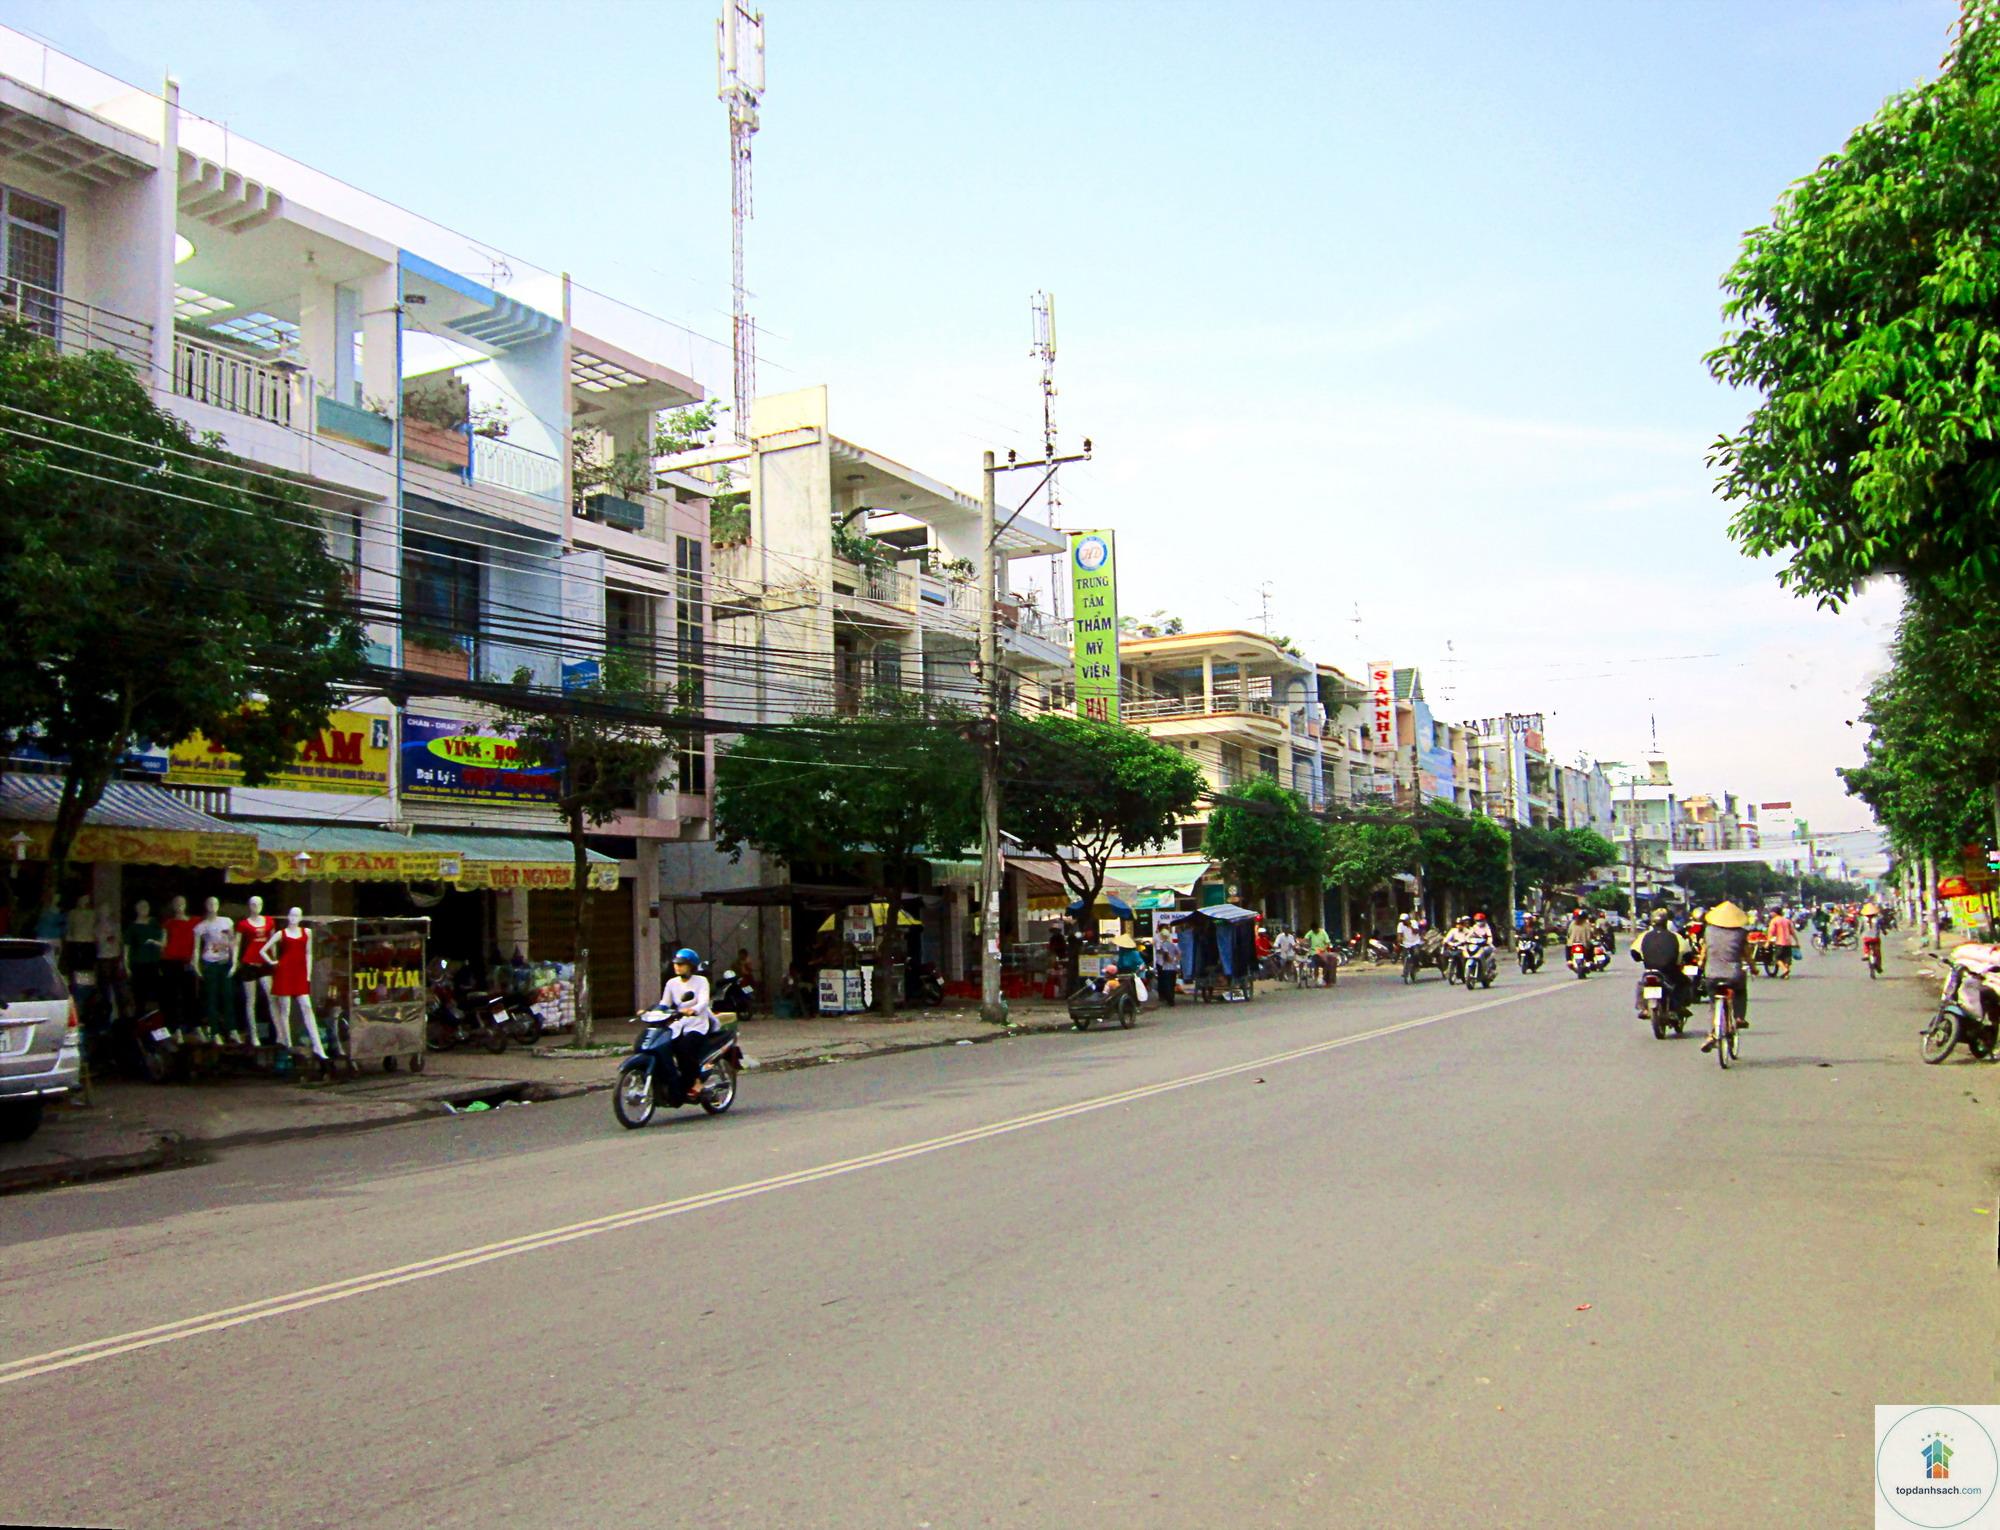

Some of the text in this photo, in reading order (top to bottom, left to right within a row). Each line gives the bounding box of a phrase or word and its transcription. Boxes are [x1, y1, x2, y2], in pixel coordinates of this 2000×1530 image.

[1076, 576, 1109, 590] TRUNG
[1083, 594, 1104, 608] TÂM
[1077, 611, 1112, 632] THẨM
[1086, 638, 1103, 655] MỸ
[1082, 662, 1110, 680] VIỆN
[332, 851, 396, 870] TÂM
[383, 966, 420, 989] TÂM
